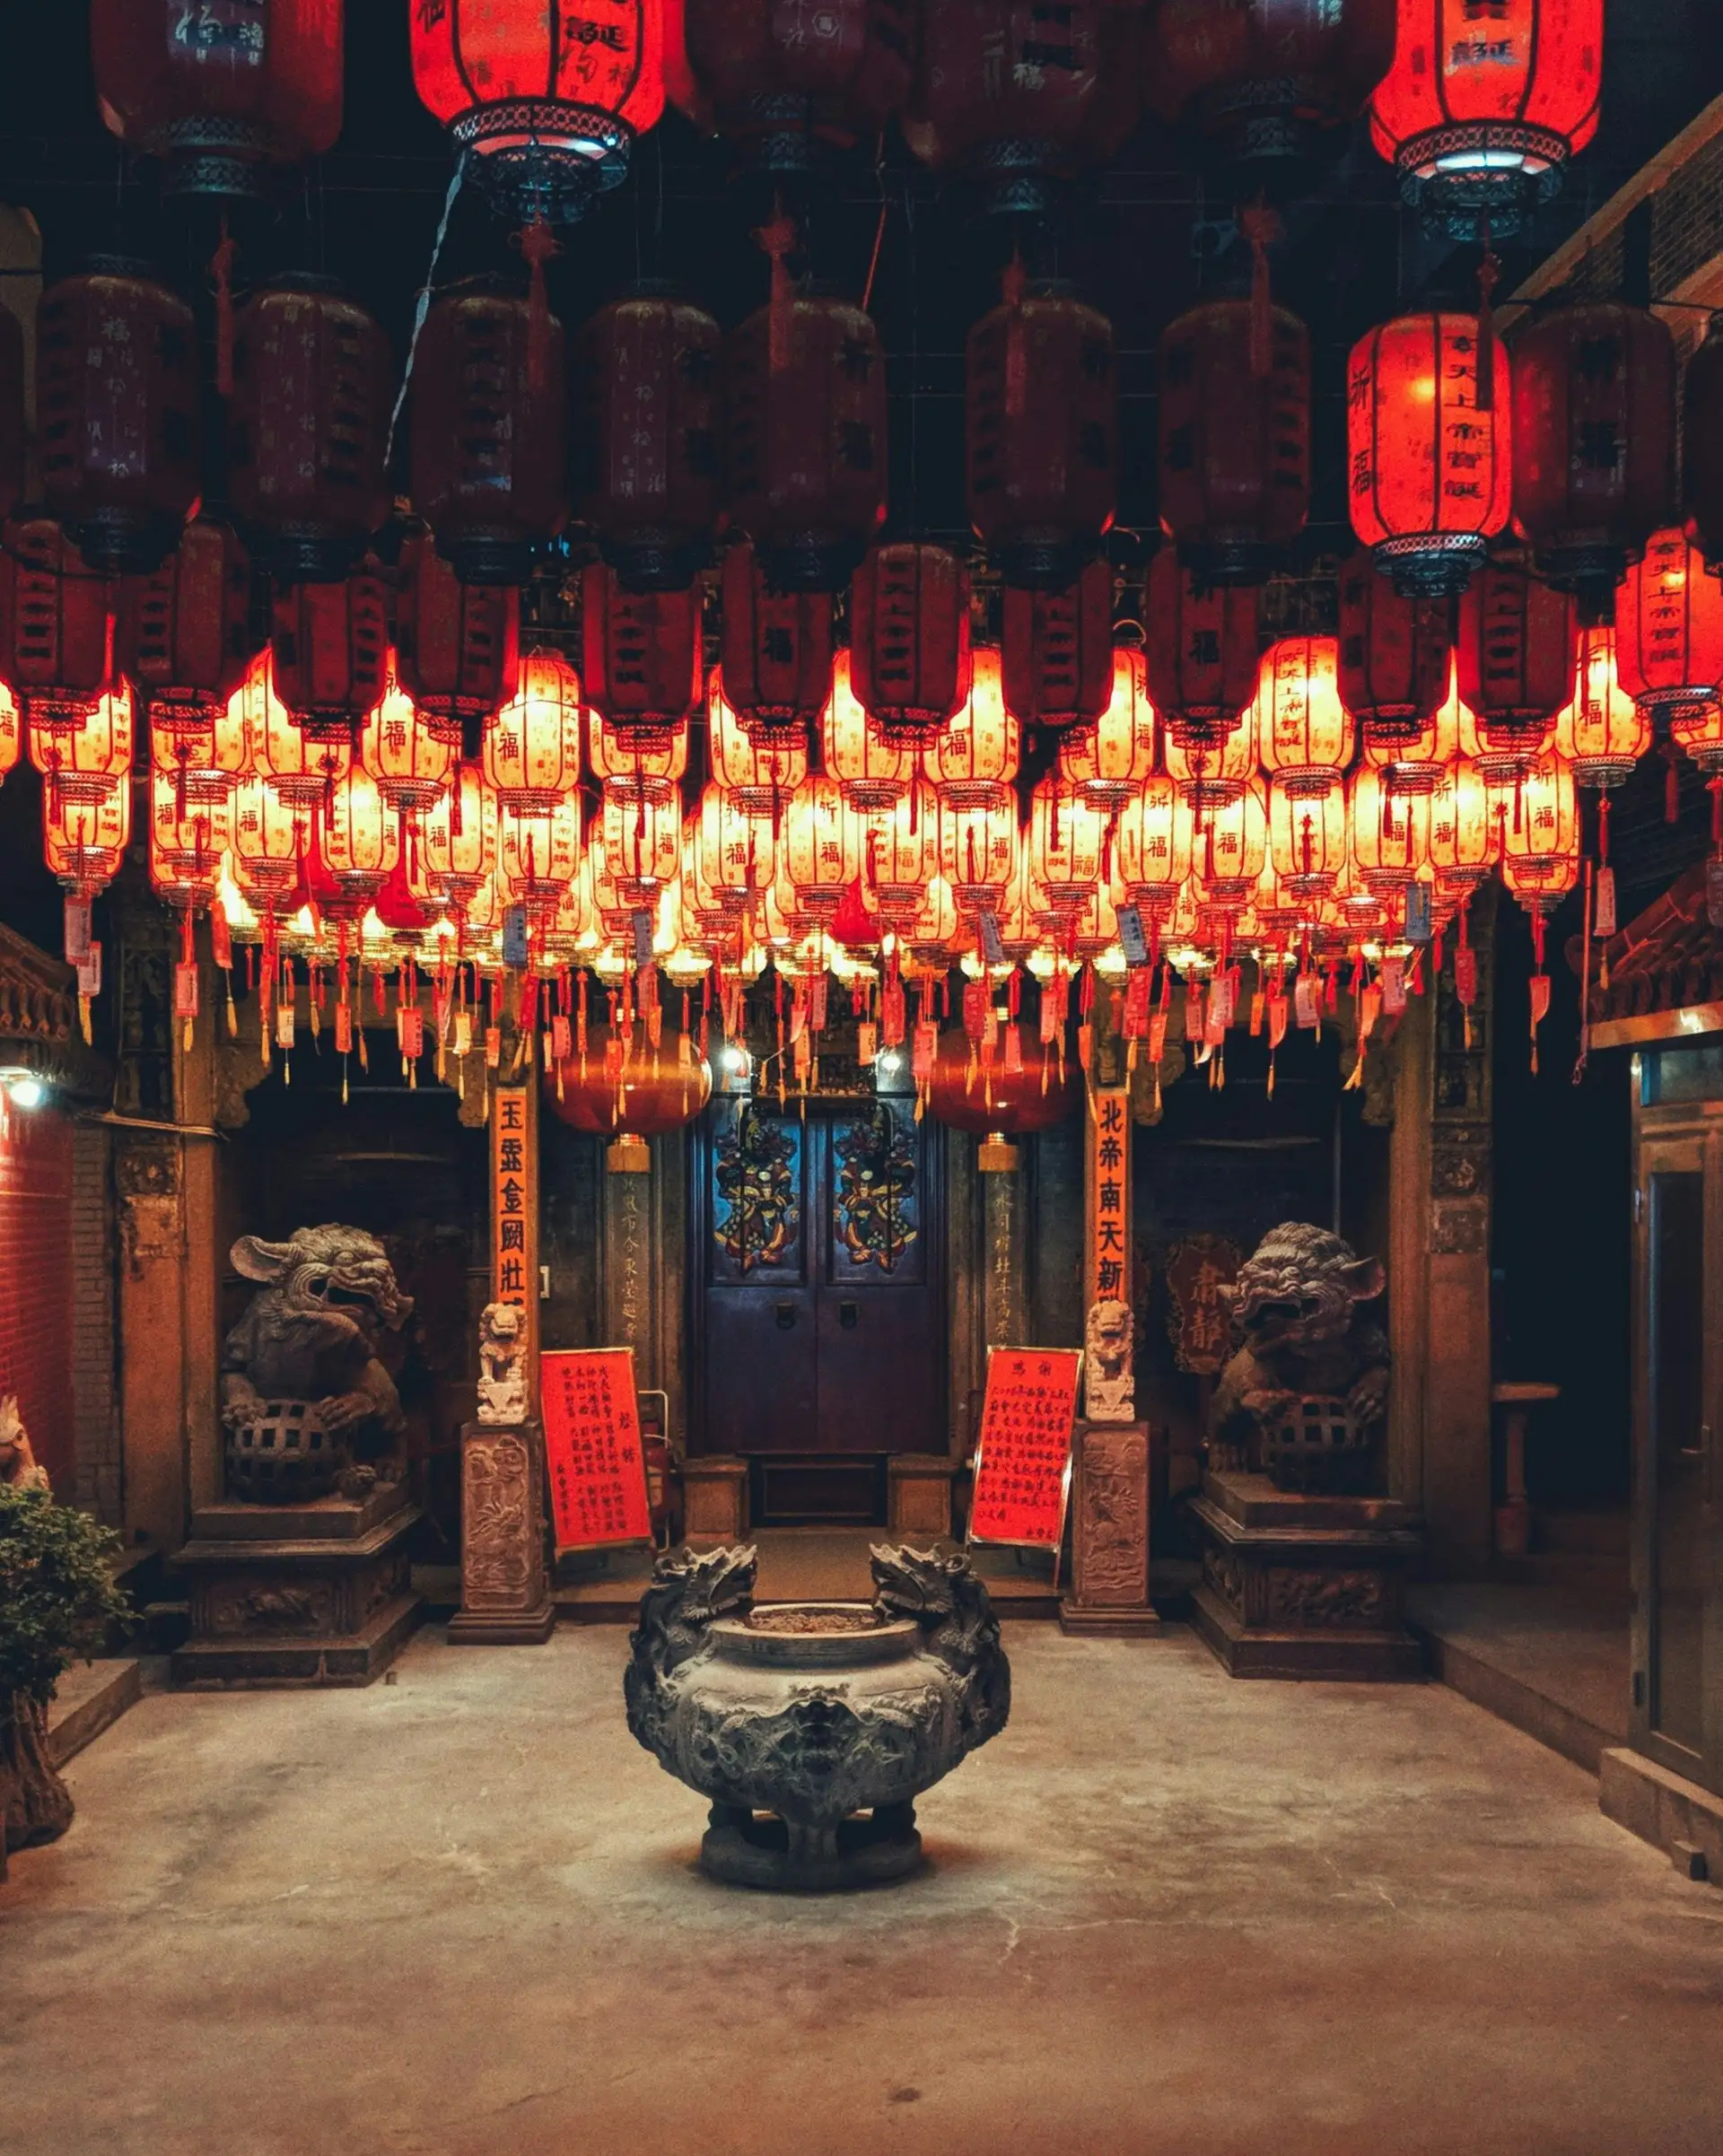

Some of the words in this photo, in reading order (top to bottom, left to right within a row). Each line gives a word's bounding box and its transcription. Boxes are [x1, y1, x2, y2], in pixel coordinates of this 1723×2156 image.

[498, 731, 519, 760] 福
[943, 729, 967, 756] 福
[1148, 795, 1168, 858] 祈福
[1433, 780, 1452, 845] 祈福
[430, 825, 447, 849] 福
[504, 831, 518, 854] 福
[659, 833, 674, 855] 福
[819, 799, 840, 864] 祈福
[1217, 832, 1238, 855] 福
[1188, 1259, 1225, 1350] 肅靜
